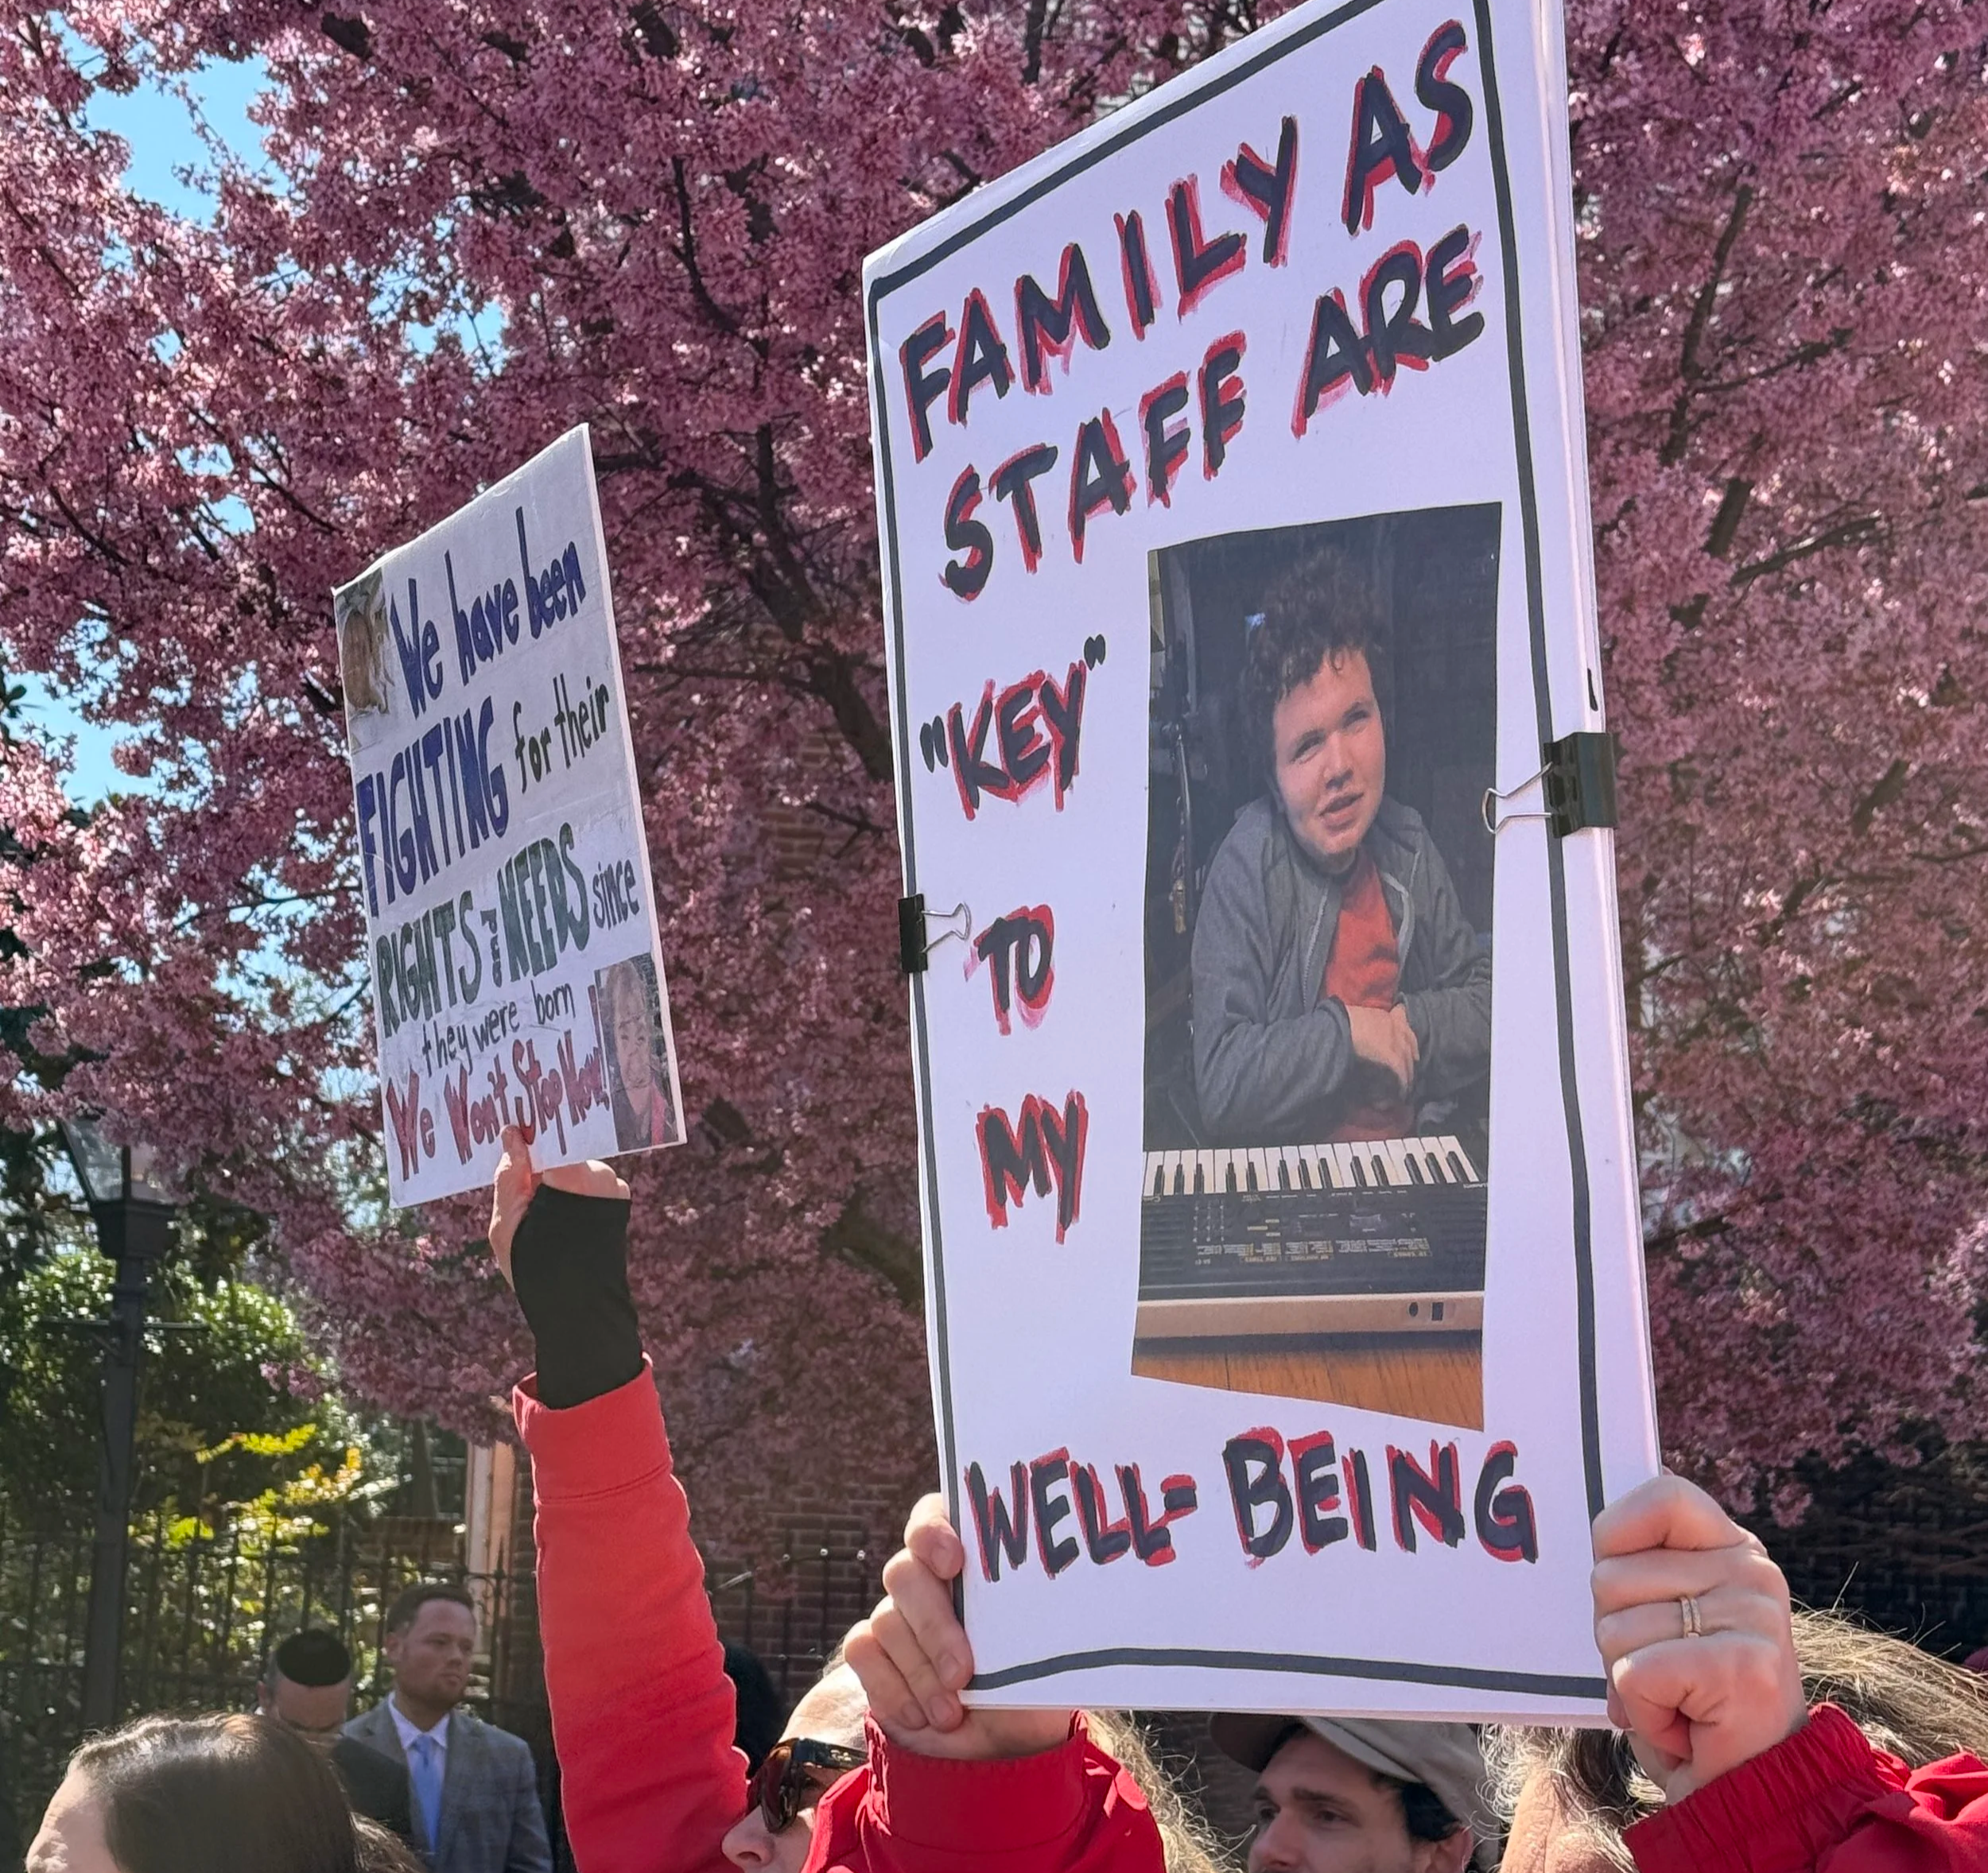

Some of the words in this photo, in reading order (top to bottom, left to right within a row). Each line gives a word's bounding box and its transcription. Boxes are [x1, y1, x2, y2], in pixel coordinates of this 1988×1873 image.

[899, 114, 1299, 463] FAMILY
[1341, 18, 1474, 236] AS
[938, 329, 1248, 603] STAFF
[1291, 223, 1485, 439] ARE
[390, 578, 443, 719] We
[445, 549, 520, 686] have
[516, 506, 587, 639] been
[356, 696, 509, 917] FIGHTING
[513, 700, 552, 793] for
[553, 673, 610, 768] their
[375, 890, 482, 1038] RIGHTS
[497, 822, 590, 982] NEEDS
[592, 859, 640, 931] since
[963, 904, 1056, 1035] TO
[386, 1064, 436, 1181] We
[512, 1038, 567, 1156] Stop
[421, 1021, 474, 1076] they
[472, 1001, 518, 1053] were
[530, 980, 577, 1026] born
[976, 1089, 1089, 1244] MY
[963, 1447, 1198, 1583] WELL-
[1221, 1426, 1540, 1570] BEING
